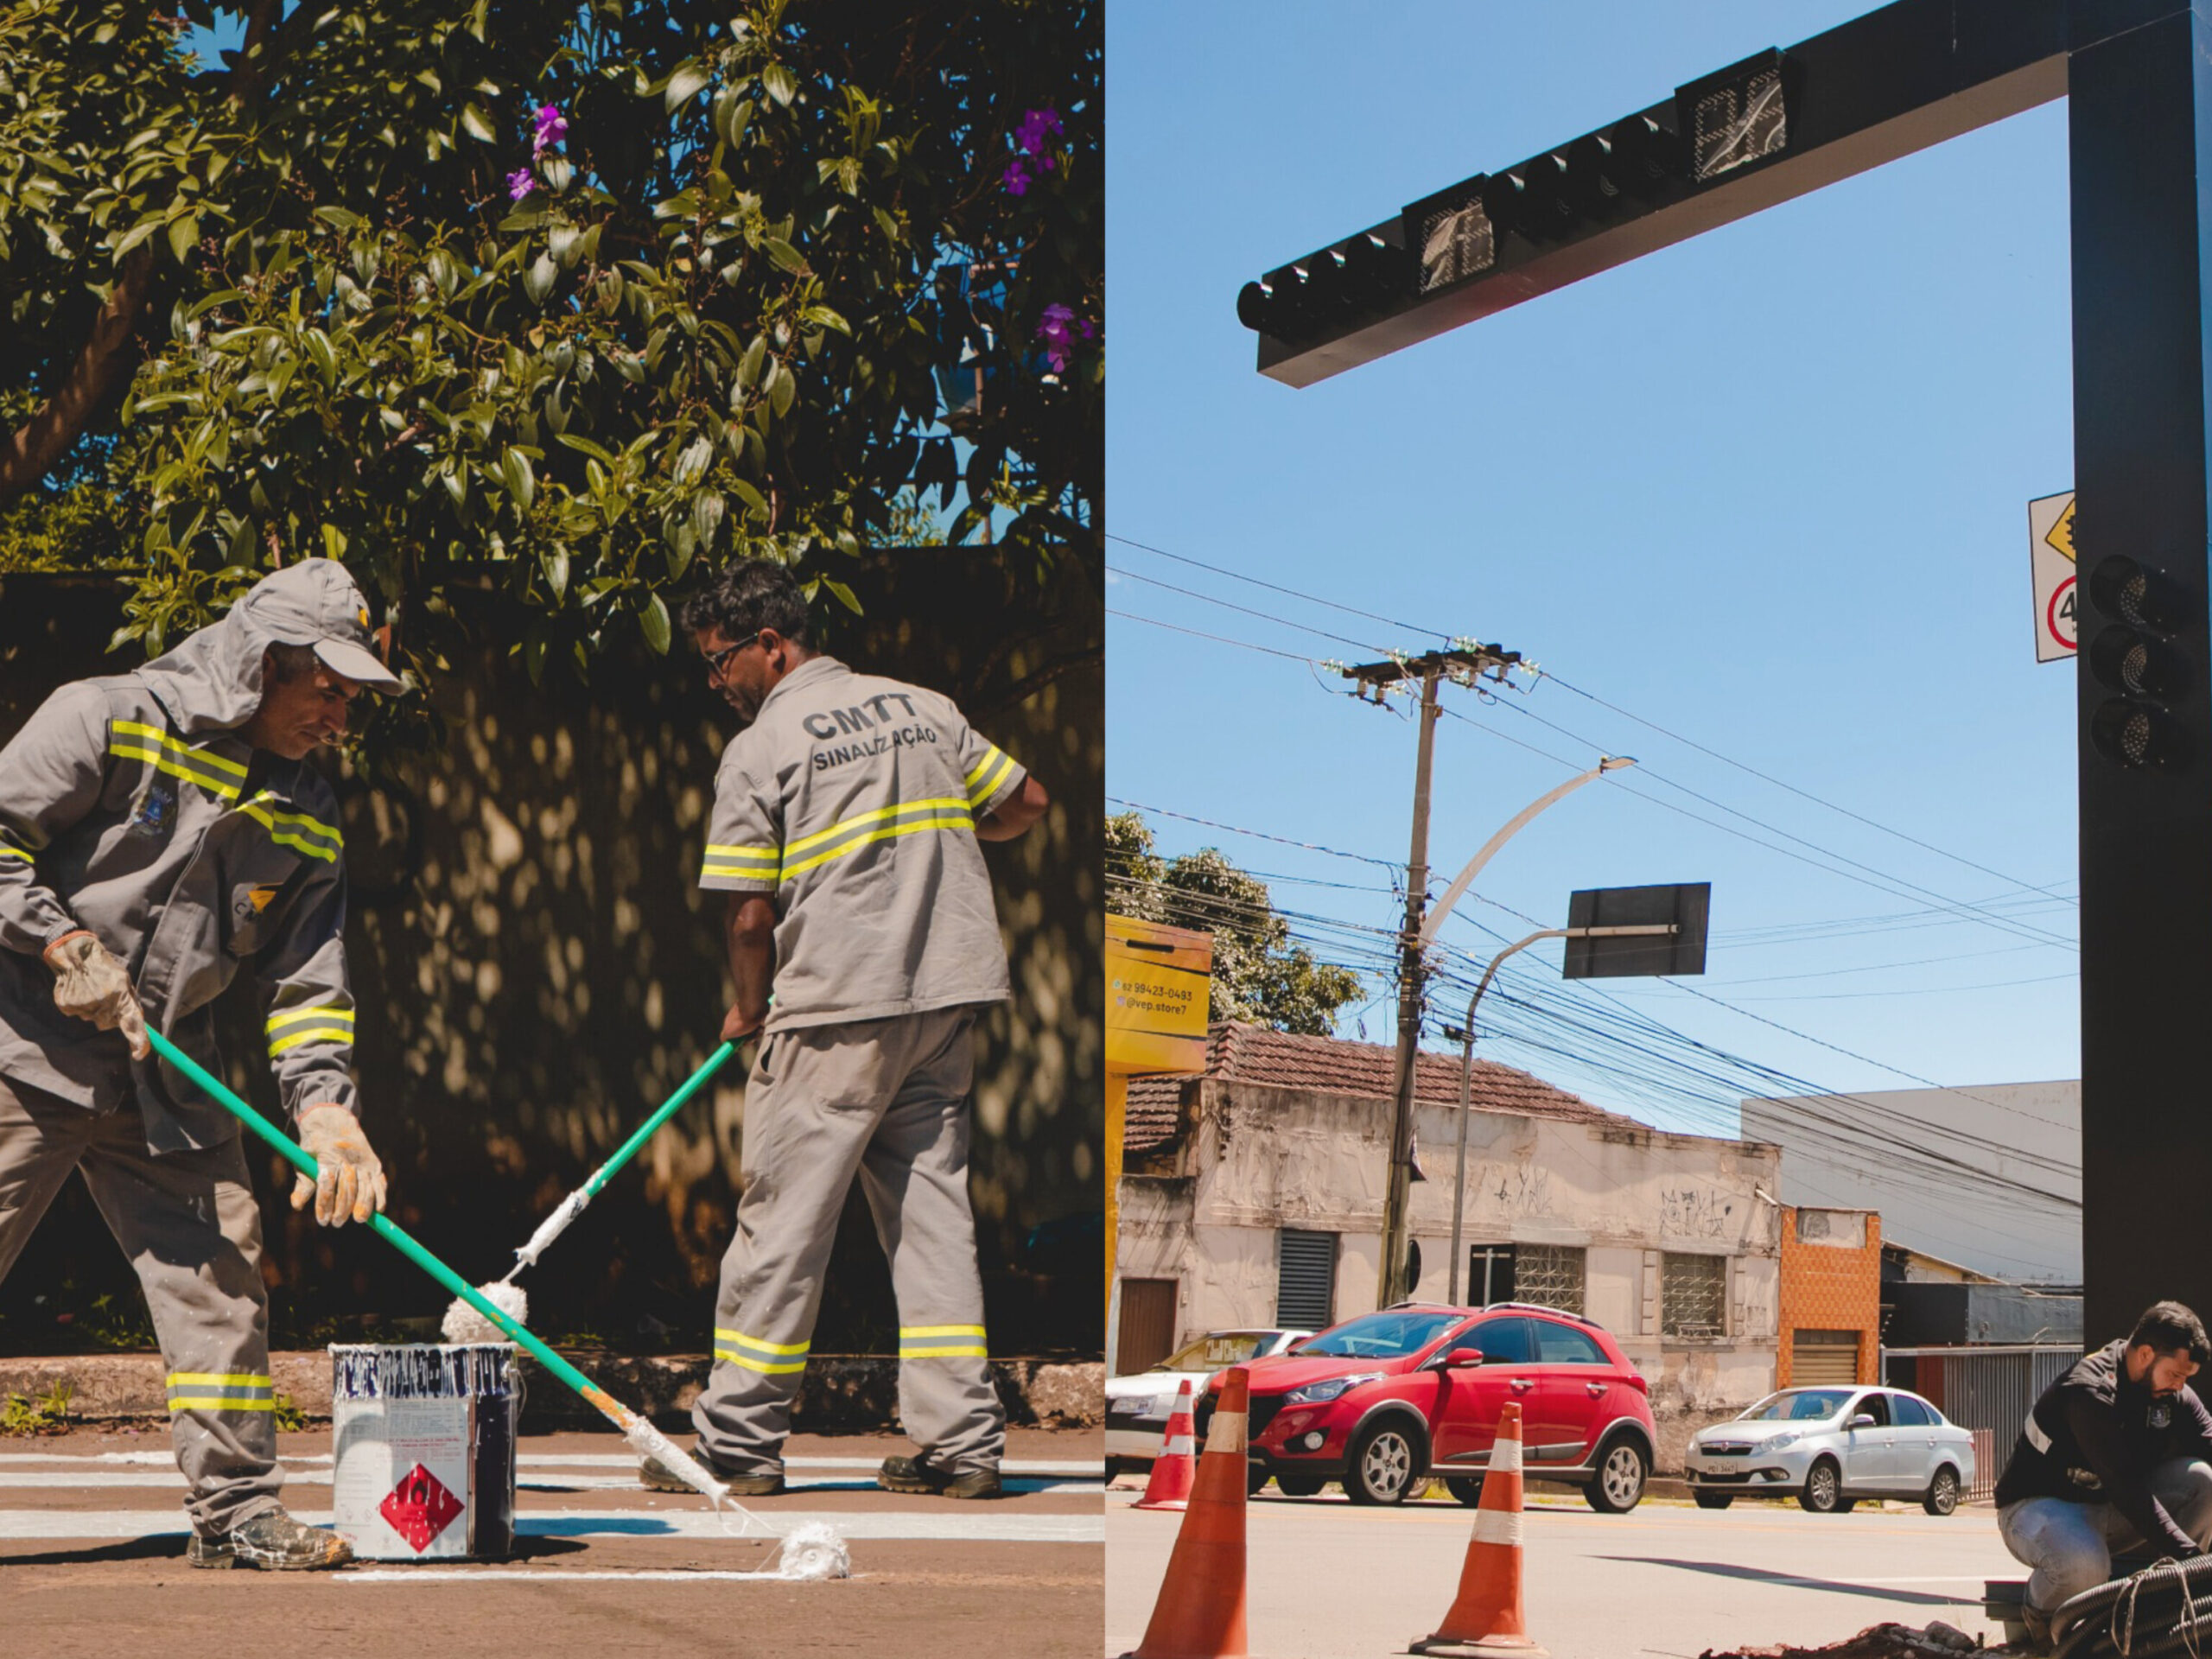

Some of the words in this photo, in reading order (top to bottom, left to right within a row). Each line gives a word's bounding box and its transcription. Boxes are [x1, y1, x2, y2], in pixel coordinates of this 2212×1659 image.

[2059, 591, 2077, 622] 4
[803, 693, 917, 740] CMTT
[814, 724, 937, 771] SINALIZAÇÃO
[1126, 996, 1186, 1015] @vep.store7
[1134, 982, 1192, 1002] 99423-0493
